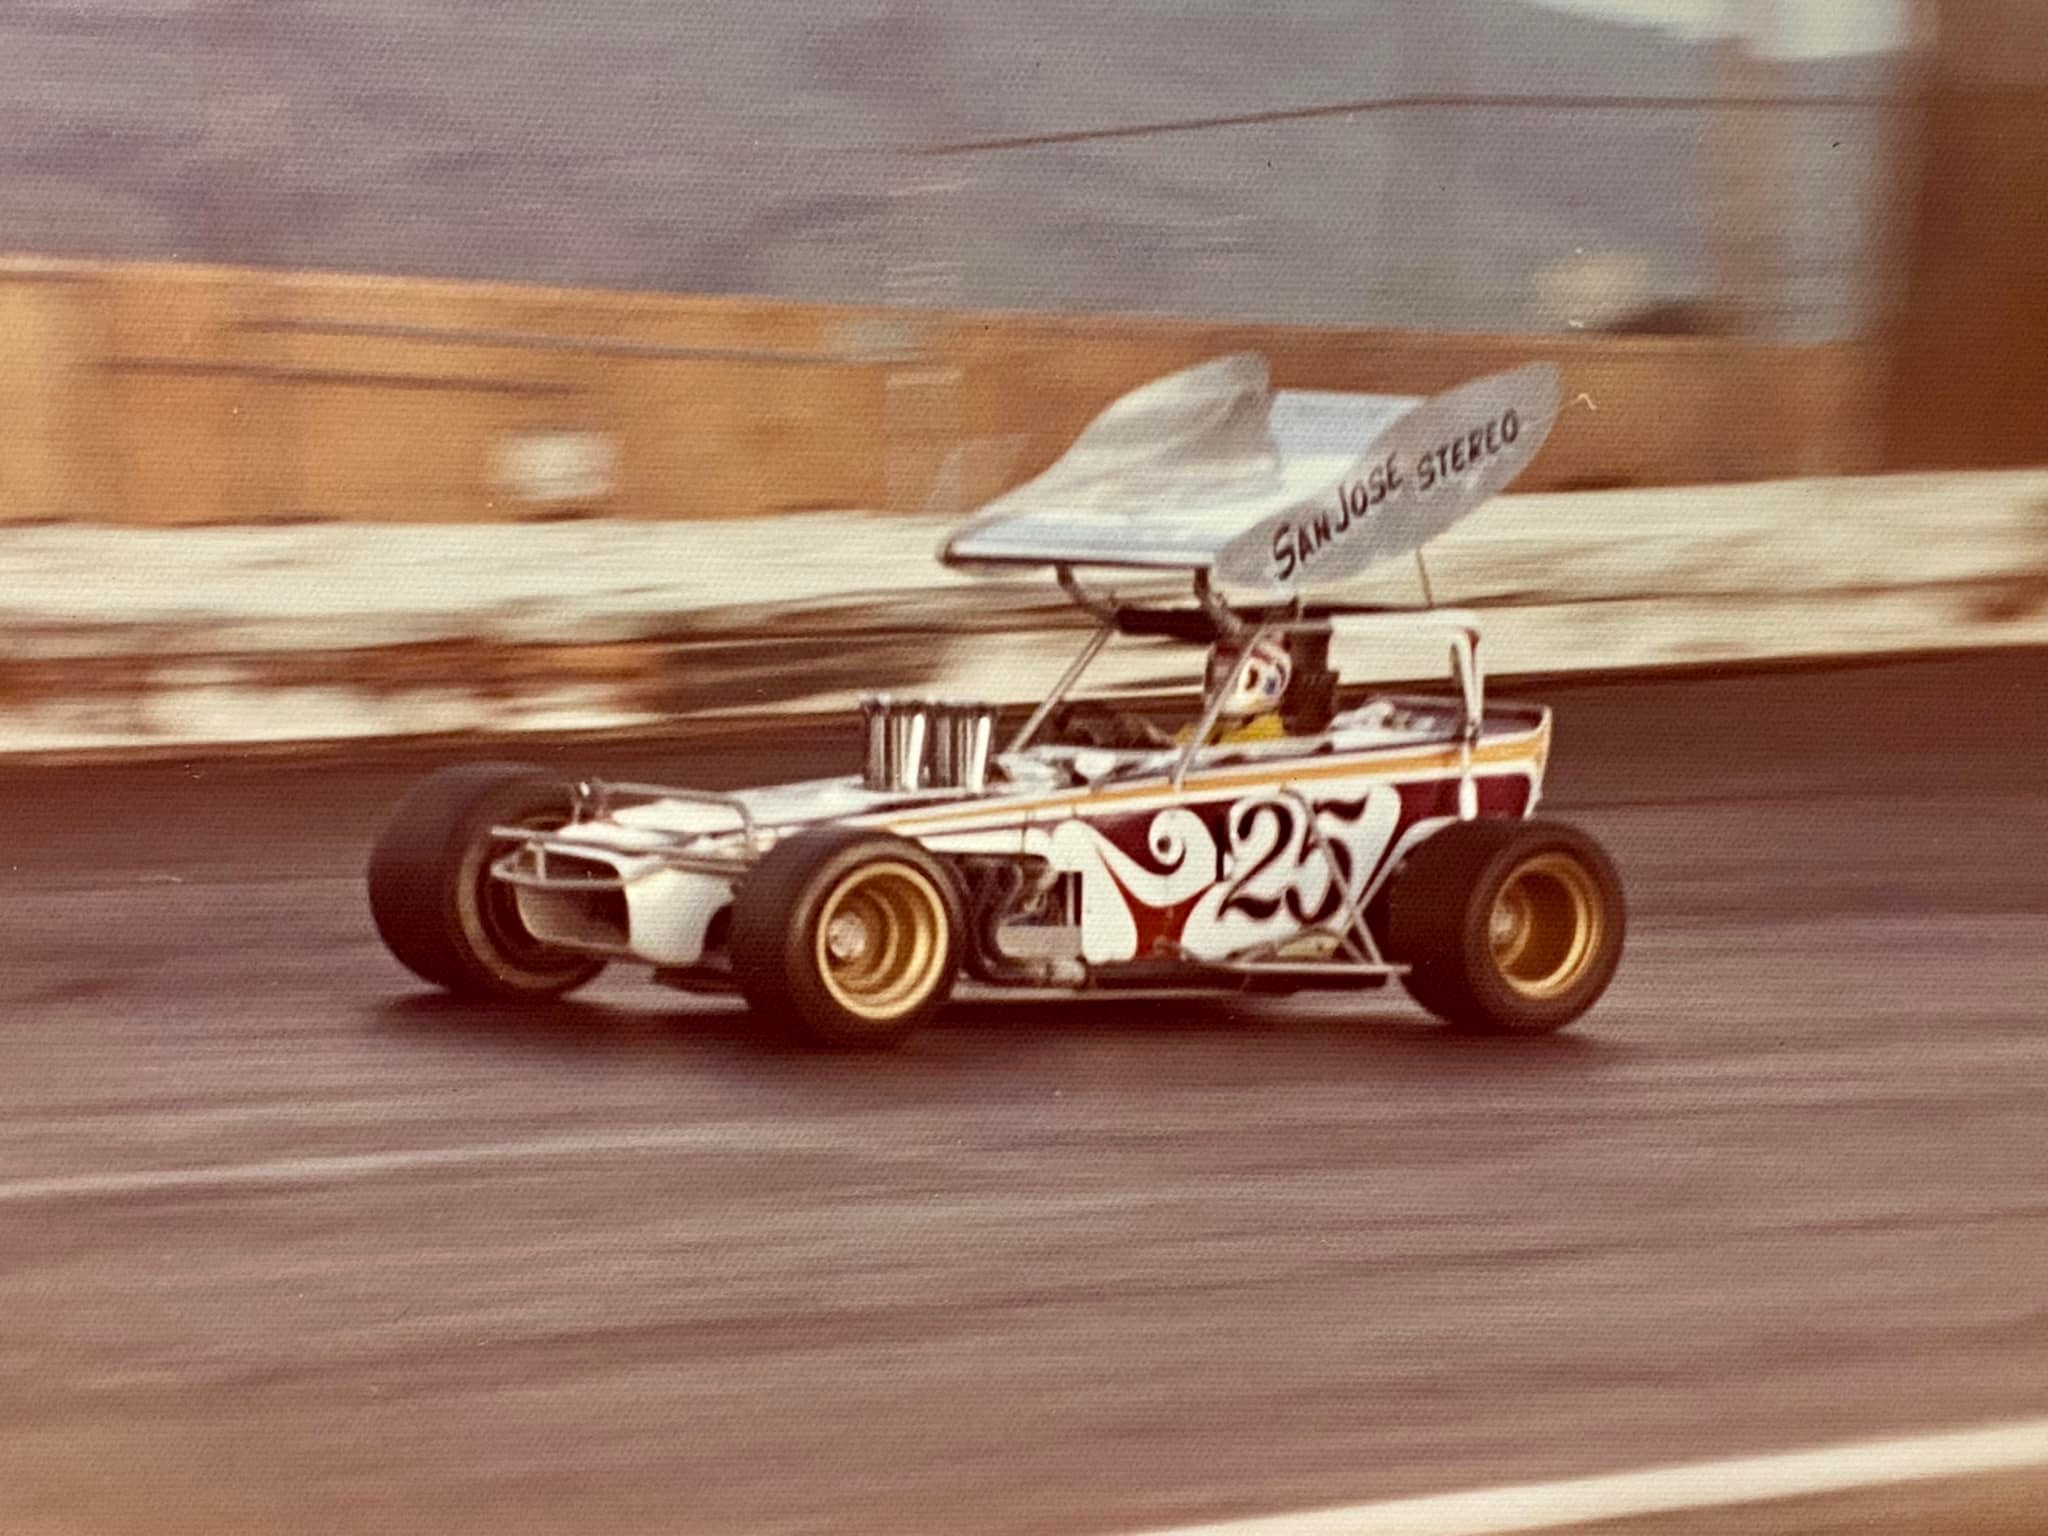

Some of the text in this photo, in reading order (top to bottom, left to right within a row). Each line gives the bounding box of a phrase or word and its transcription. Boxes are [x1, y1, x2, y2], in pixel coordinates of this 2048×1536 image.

[1273, 408, 1519, 580] SAN JOSE STEREO
[1216, 798, 1370, 924] 25
